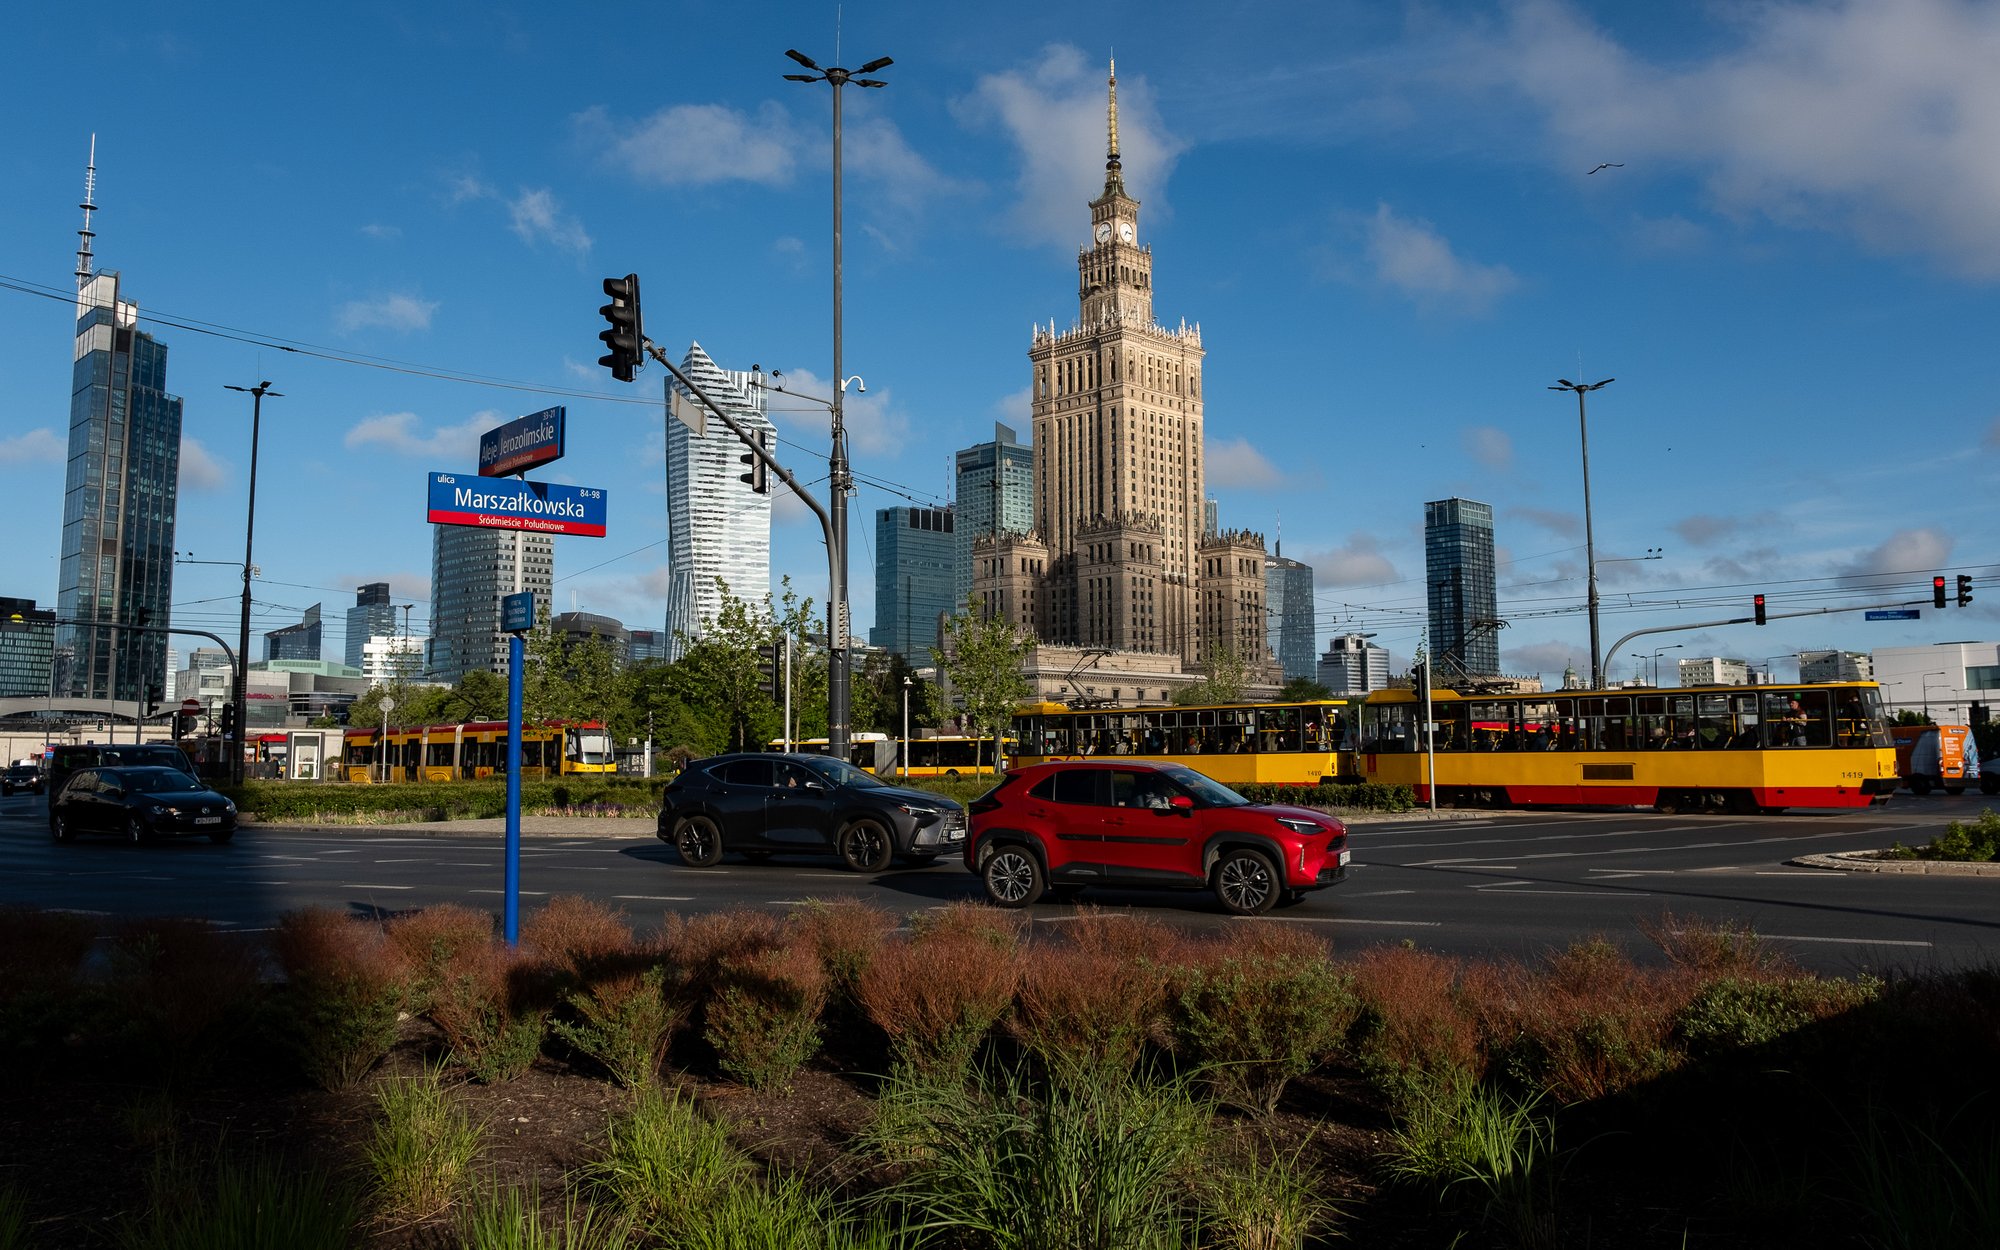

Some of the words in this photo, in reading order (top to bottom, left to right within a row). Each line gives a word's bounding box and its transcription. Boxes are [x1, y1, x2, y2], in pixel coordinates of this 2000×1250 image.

[481, 441, 498, 464] Aleje
[500, 422, 555, 456] Jerozolimskie
[437, 474, 455, 484] ulica
[580, 489, 600, 499] 84-98
[455, 487, 585, 518] Marszałkowska
[478, 513, 521, 527] Śródmieście
[524, 519, 565, 531] Południowe
[1841, 771, 1864, 779] 1419
